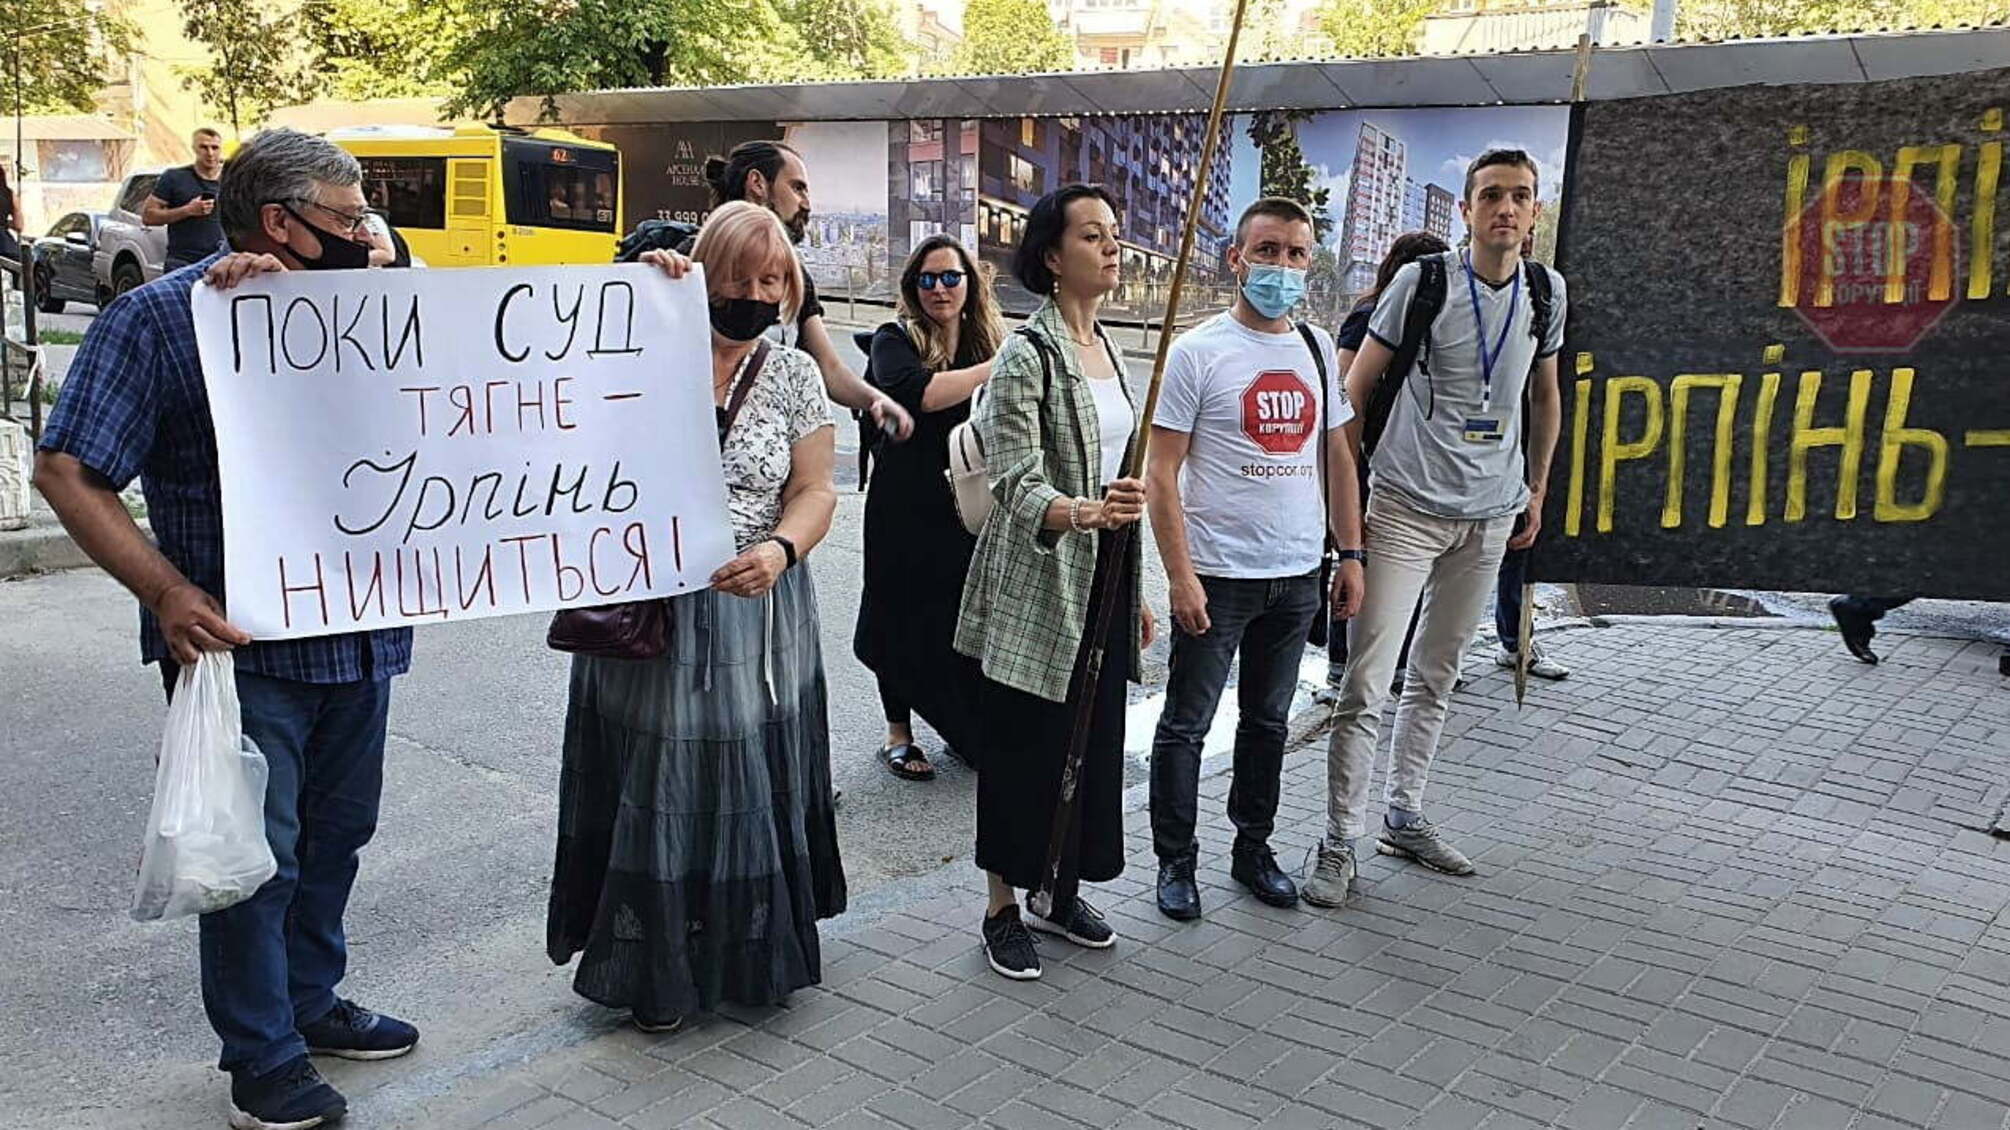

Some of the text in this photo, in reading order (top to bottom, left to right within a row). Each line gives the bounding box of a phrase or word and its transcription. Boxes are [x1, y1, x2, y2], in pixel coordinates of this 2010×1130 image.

[552, 149, 568, 163] 62
[231, 281, 643, 373] ПОКИ СУД
[400, 377, 576, 437] ТЯГНЕ
[1256, 391, 1304, 419] STOP
[334, 449, 638, 544] Ірпінь
[278, 515, 686, 628] НИЩИТЬСЯ!
